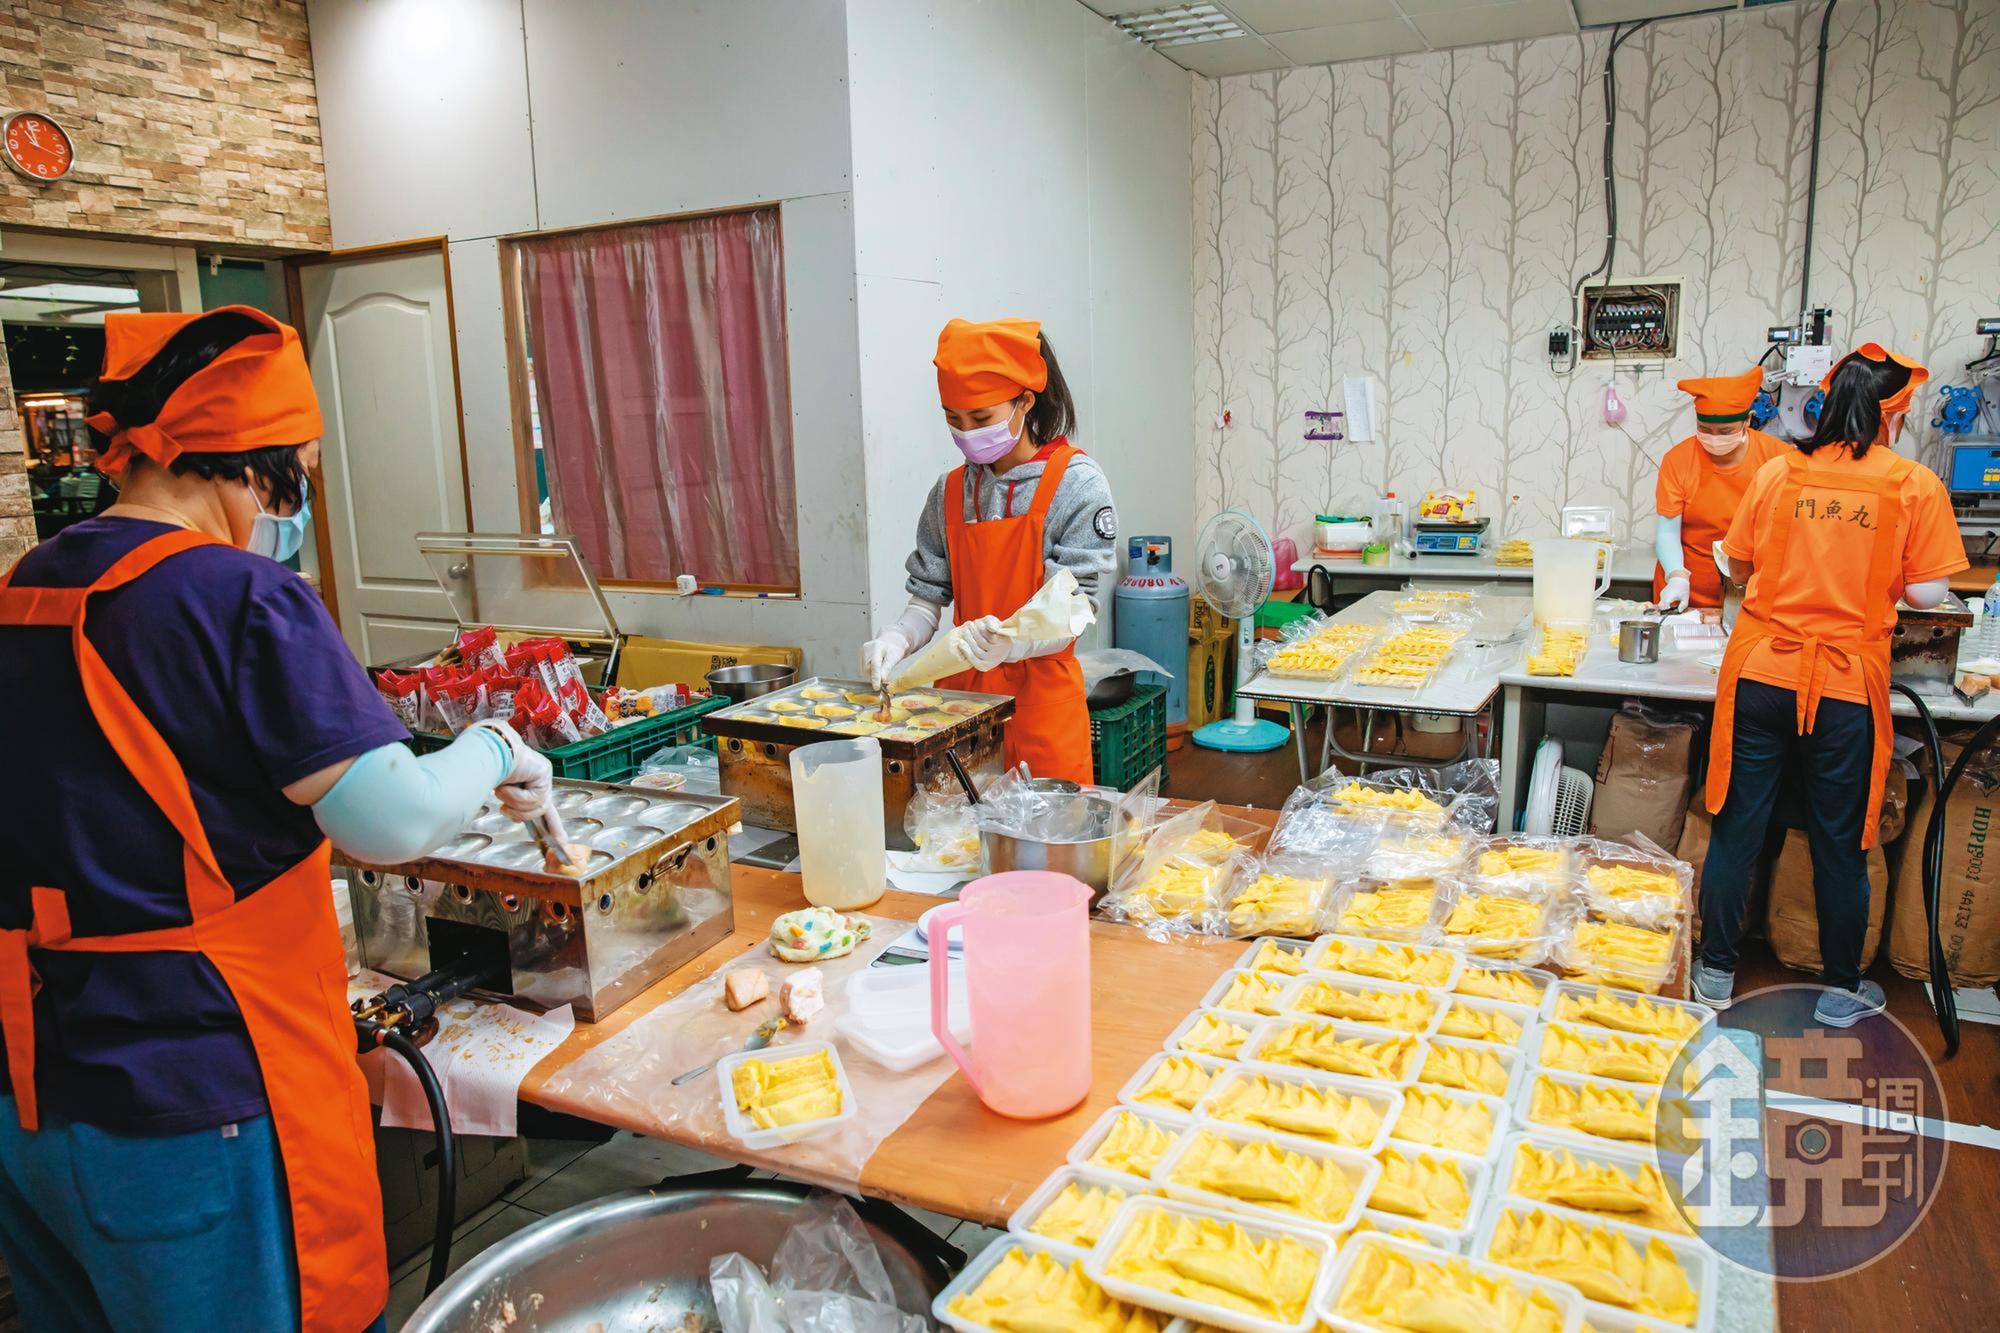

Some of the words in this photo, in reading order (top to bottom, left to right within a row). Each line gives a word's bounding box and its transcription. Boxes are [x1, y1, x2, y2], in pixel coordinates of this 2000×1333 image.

[55, 144, 65, 155] 3
[37, 164, 48, 175] 6
[1794, 499, 1878, 530] 門魚丸
[1967, 806, 1992, 854] HDPE
